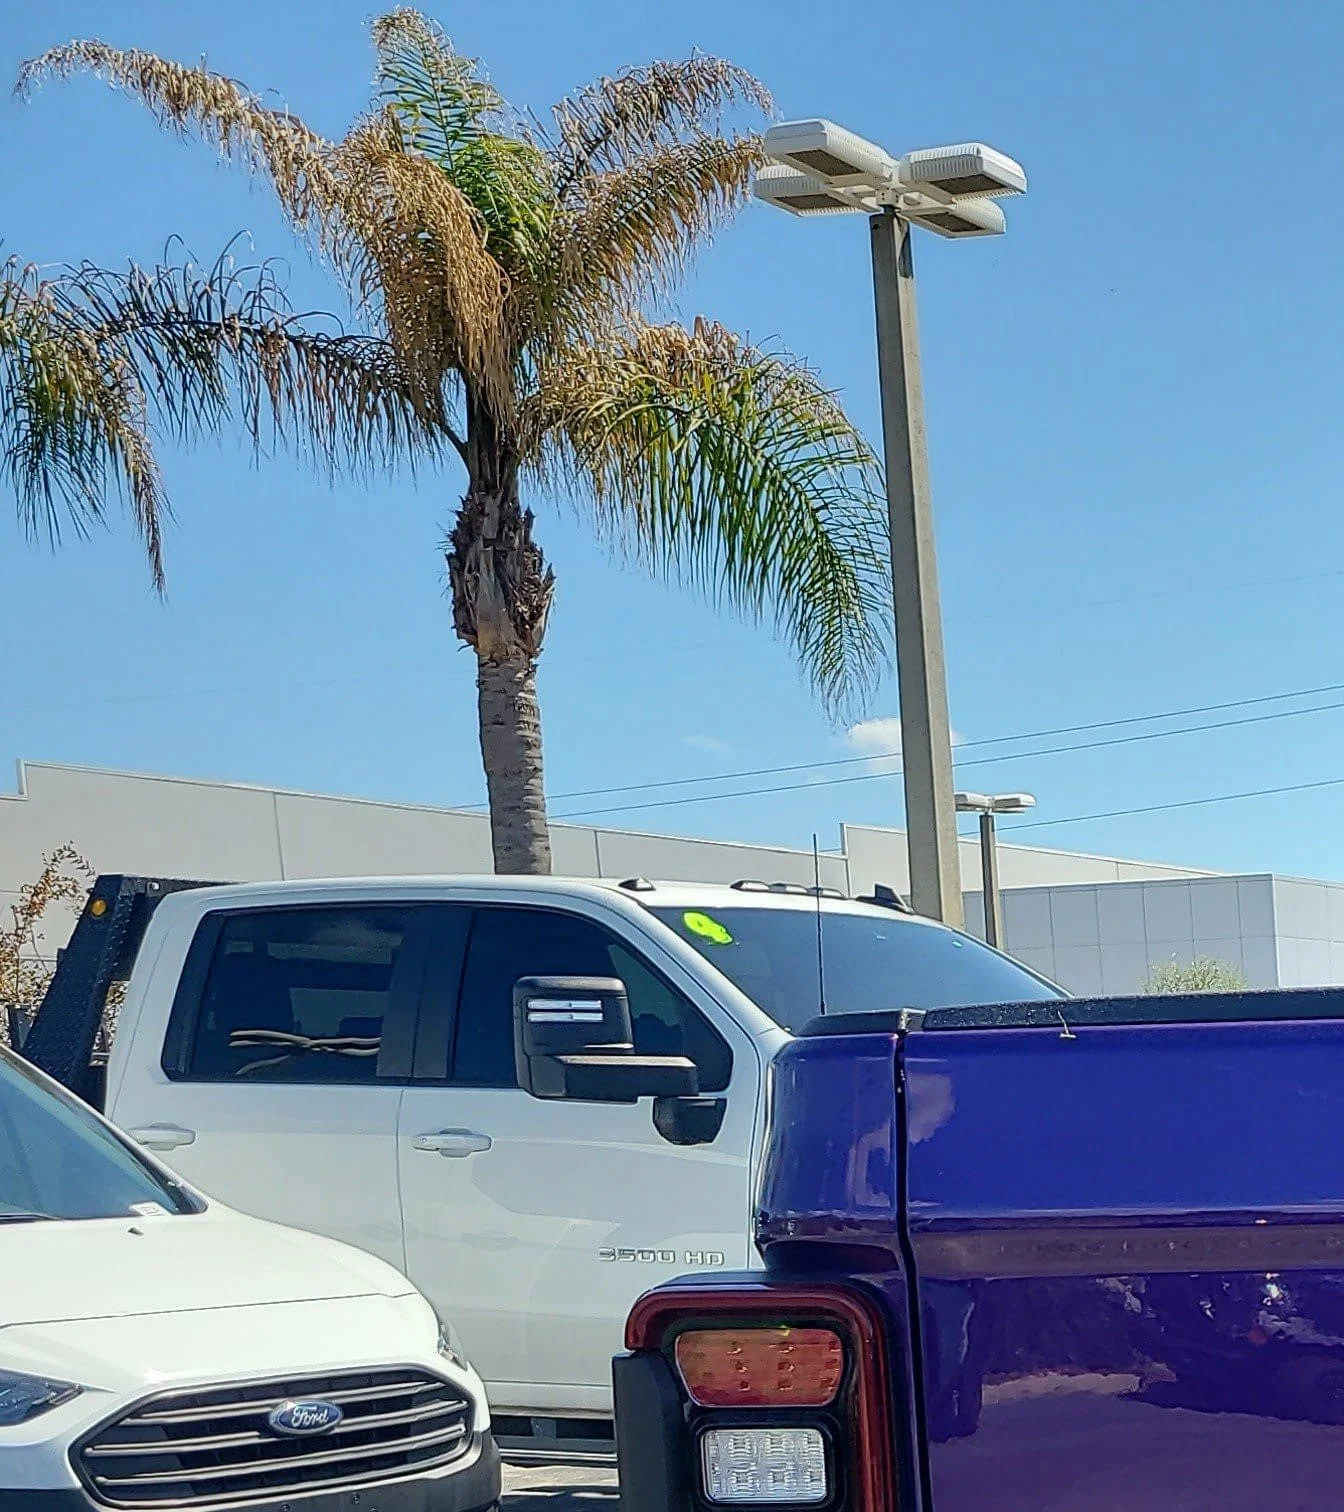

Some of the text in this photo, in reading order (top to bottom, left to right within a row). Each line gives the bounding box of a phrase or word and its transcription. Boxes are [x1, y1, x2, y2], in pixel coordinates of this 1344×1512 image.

[598, 1247, 725, 1265] 3500 HD
[291, 1404, 329, 1428] Ford
